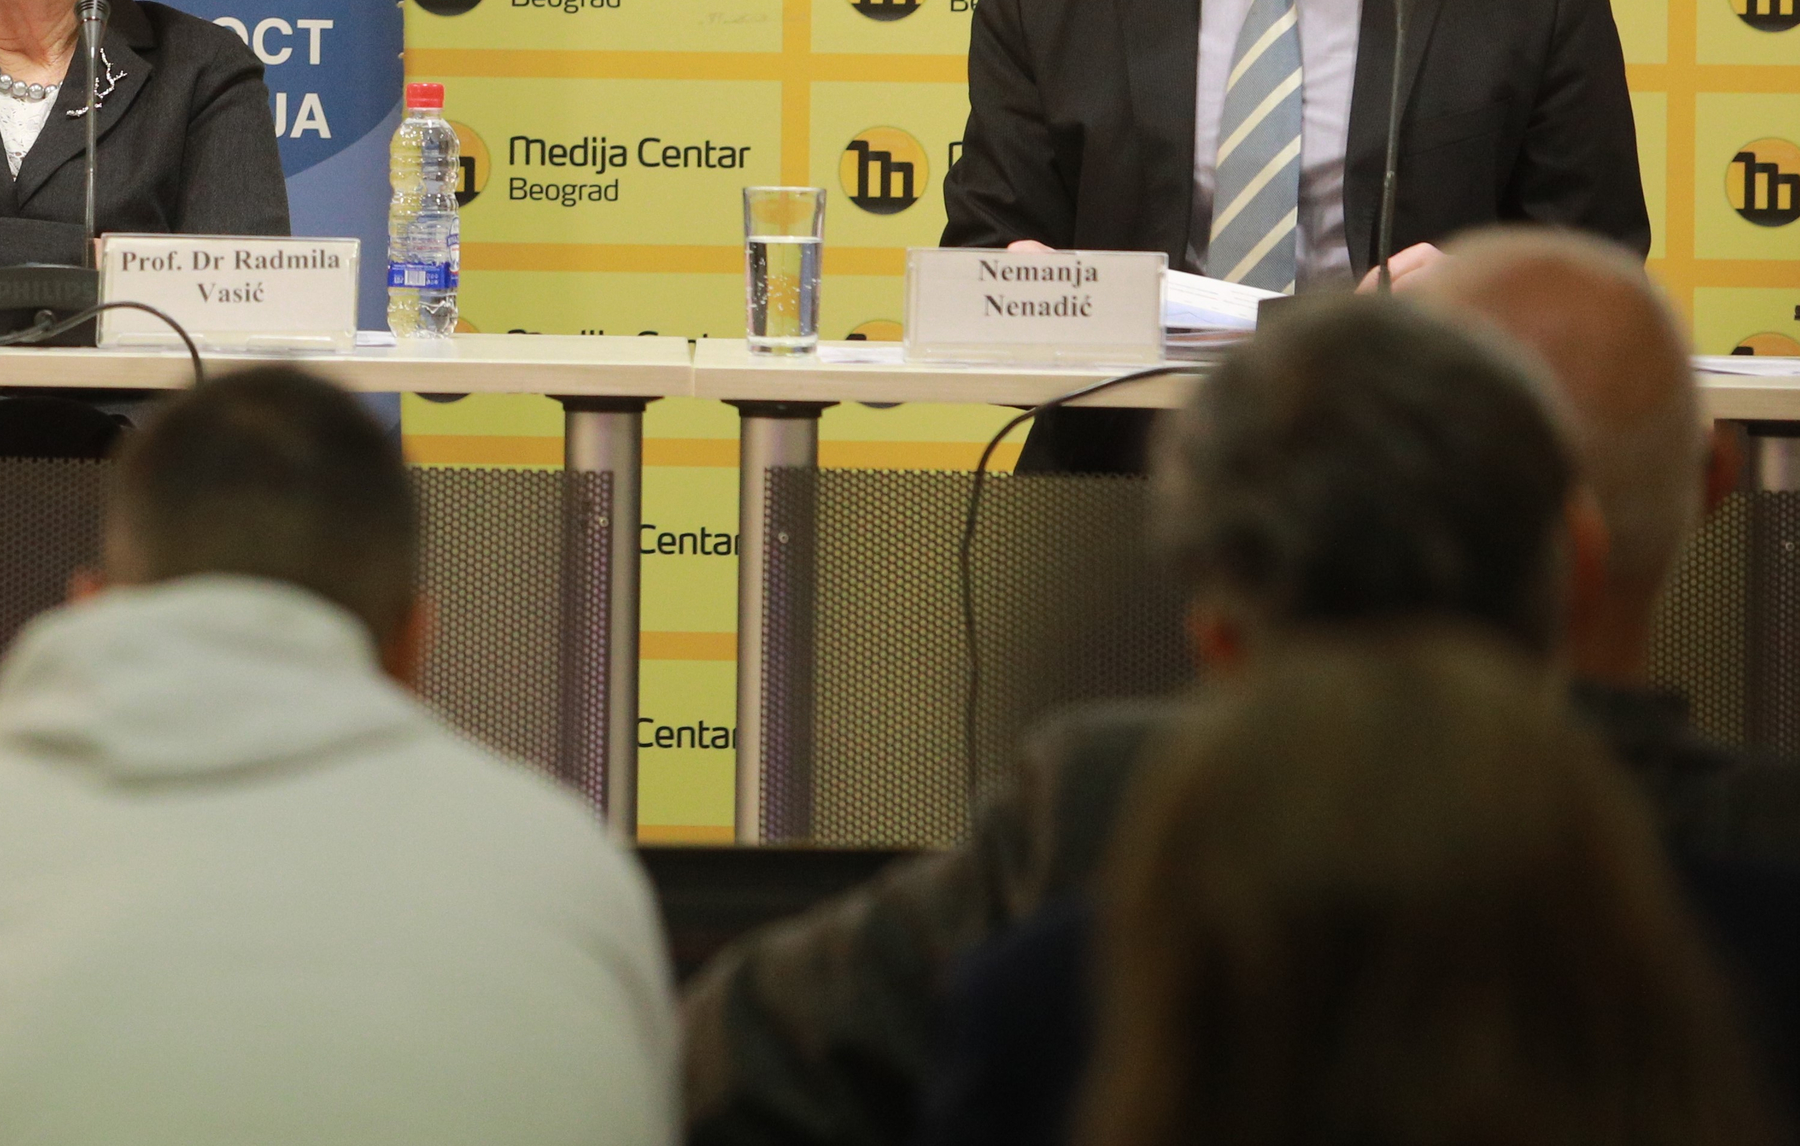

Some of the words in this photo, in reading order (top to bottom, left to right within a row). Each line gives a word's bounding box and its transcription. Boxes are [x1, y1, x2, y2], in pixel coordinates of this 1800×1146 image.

[509, 135, 628, 175] Medija
[637, 137, 752, 169] Centar
[509, 176, 619, 208] Beograd
[122, 250, 182, 272] Prof.
[192, 250, 226, 271] Dr
[235, 249, 340, 270] Radmila
[979, 260, 1098, 287] Nemanja
[197, 282, 264, 303] Vasić
[985, 293, 1092, 317] Nenadić
